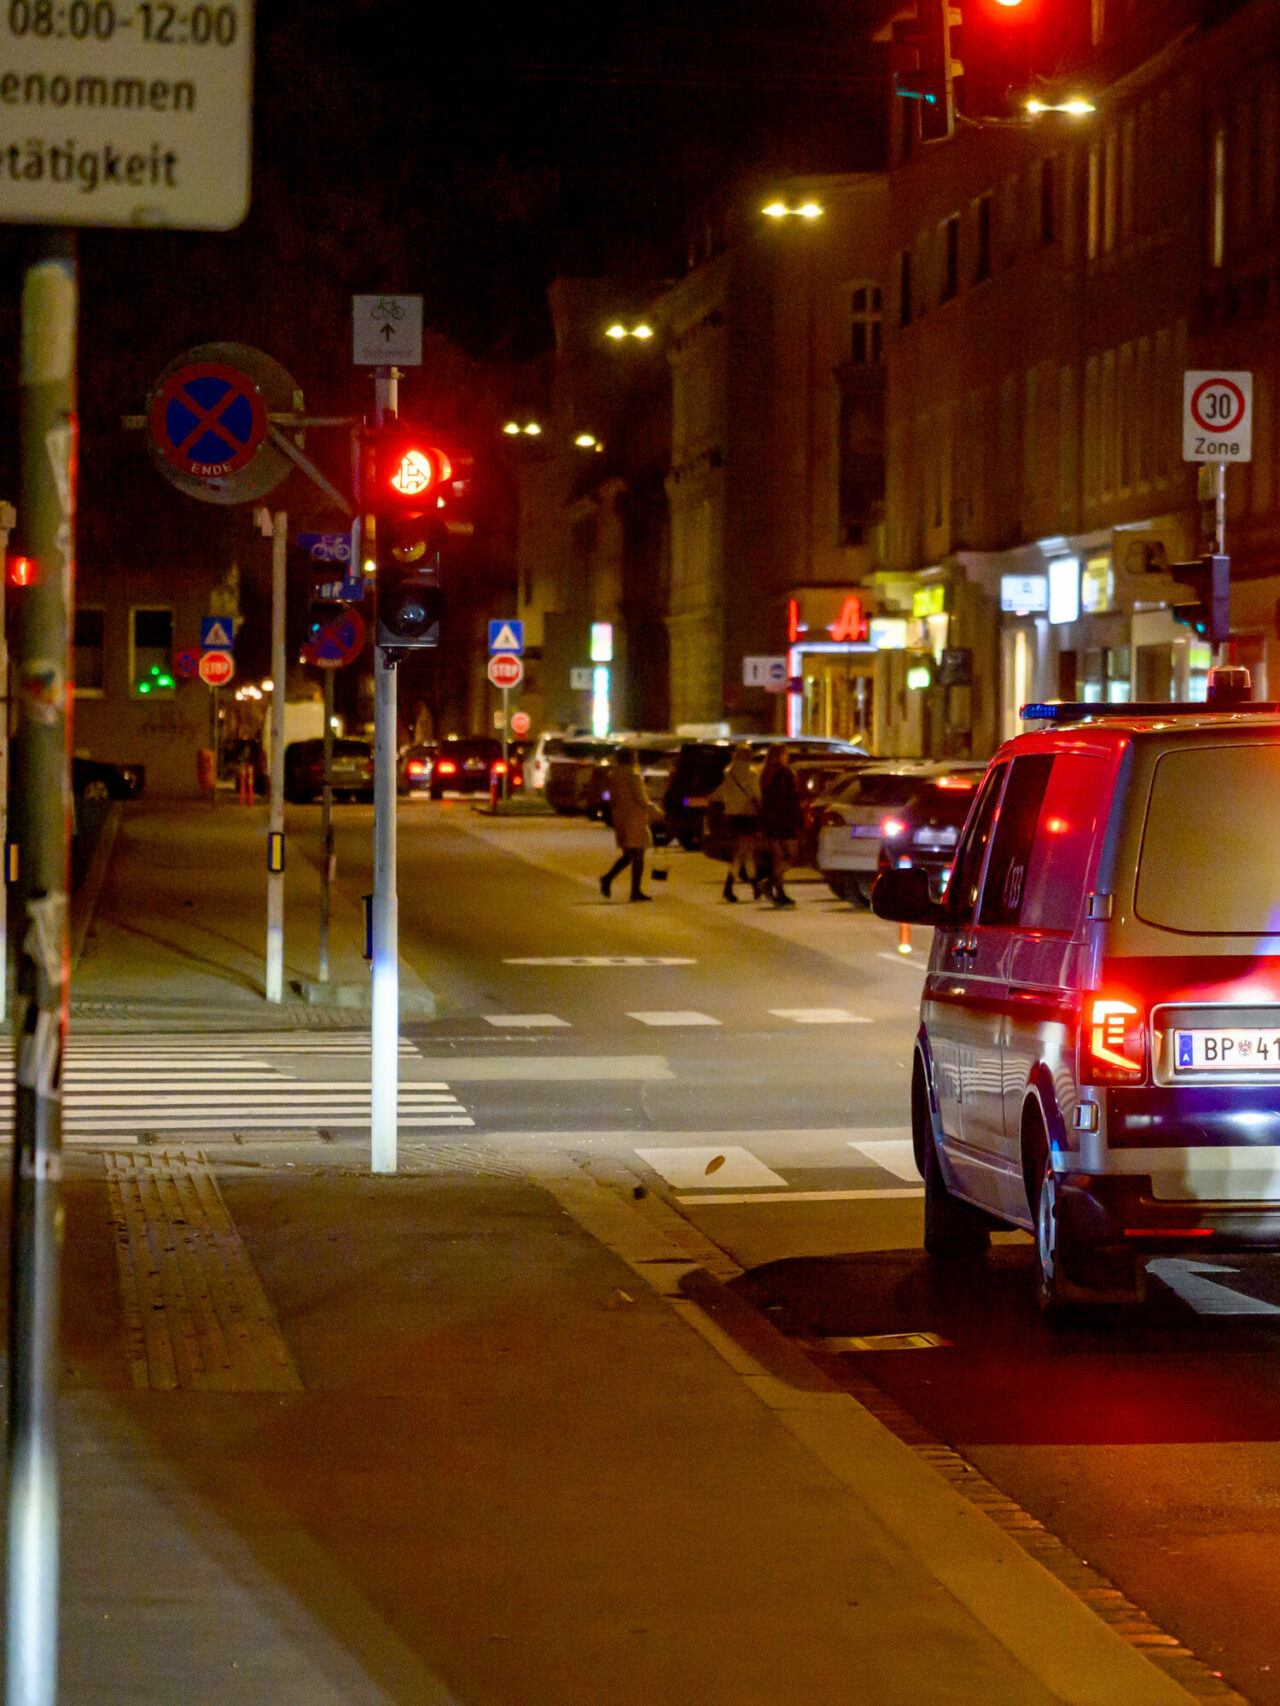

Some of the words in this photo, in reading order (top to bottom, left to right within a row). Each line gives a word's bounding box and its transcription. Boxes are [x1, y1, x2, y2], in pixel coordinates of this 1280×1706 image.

[0, 138, 177, 193] tätigkeit
[1205, 393, 1231, 419] 30
[1194, 437, 1240, 455] Zone
[191, 461, 233, 476] ENDE
[201, 661, 231, 675] STOP
[491, 663, 519, 677] STOP
[1204, 1037, 1235, 1061] BP
